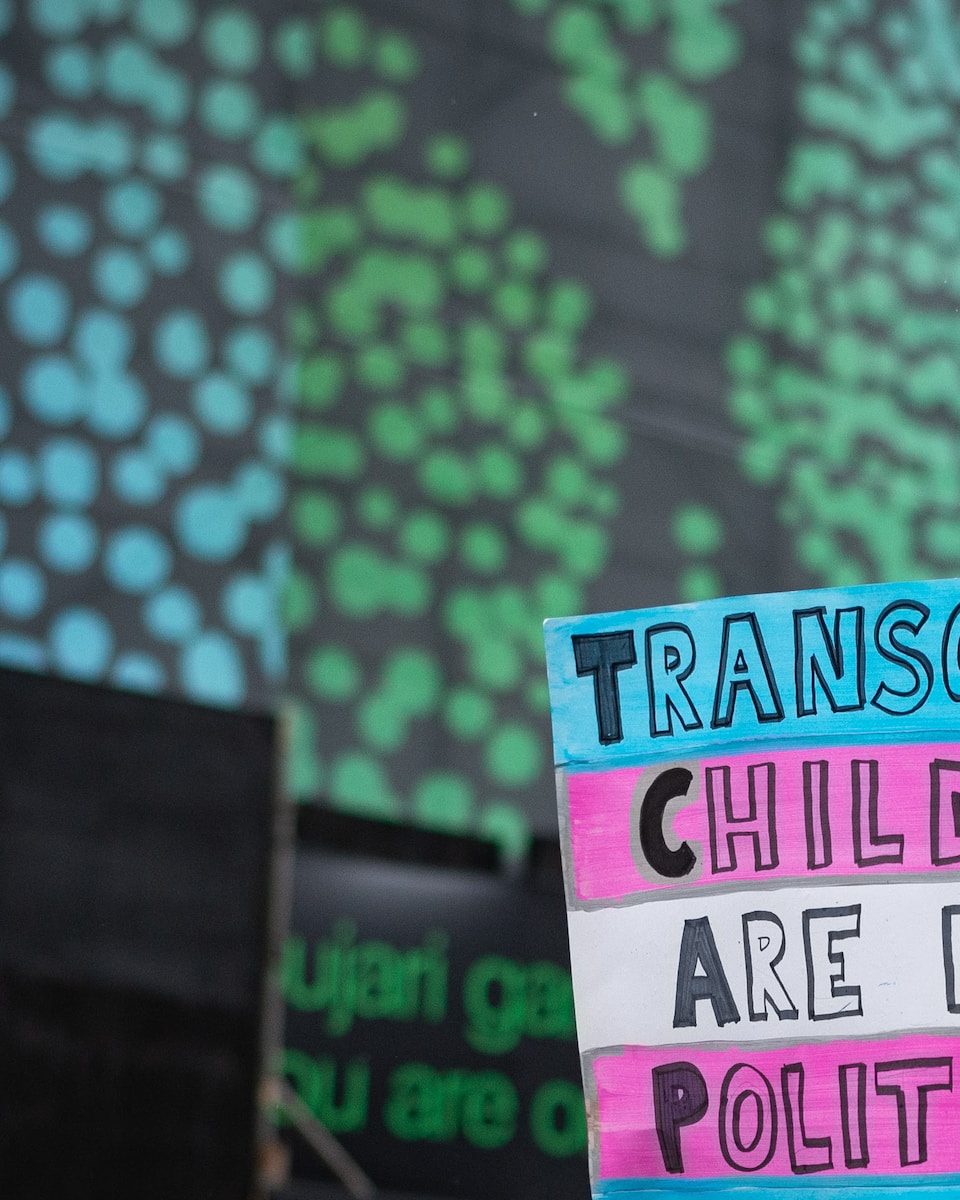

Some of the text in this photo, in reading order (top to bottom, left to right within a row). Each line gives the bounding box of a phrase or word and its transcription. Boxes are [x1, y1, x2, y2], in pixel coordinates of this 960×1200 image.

[463, 953, 578, 1057] ga
[672, 903, 863, 1028] ARE
[384, 1060, 518, 1150] are
